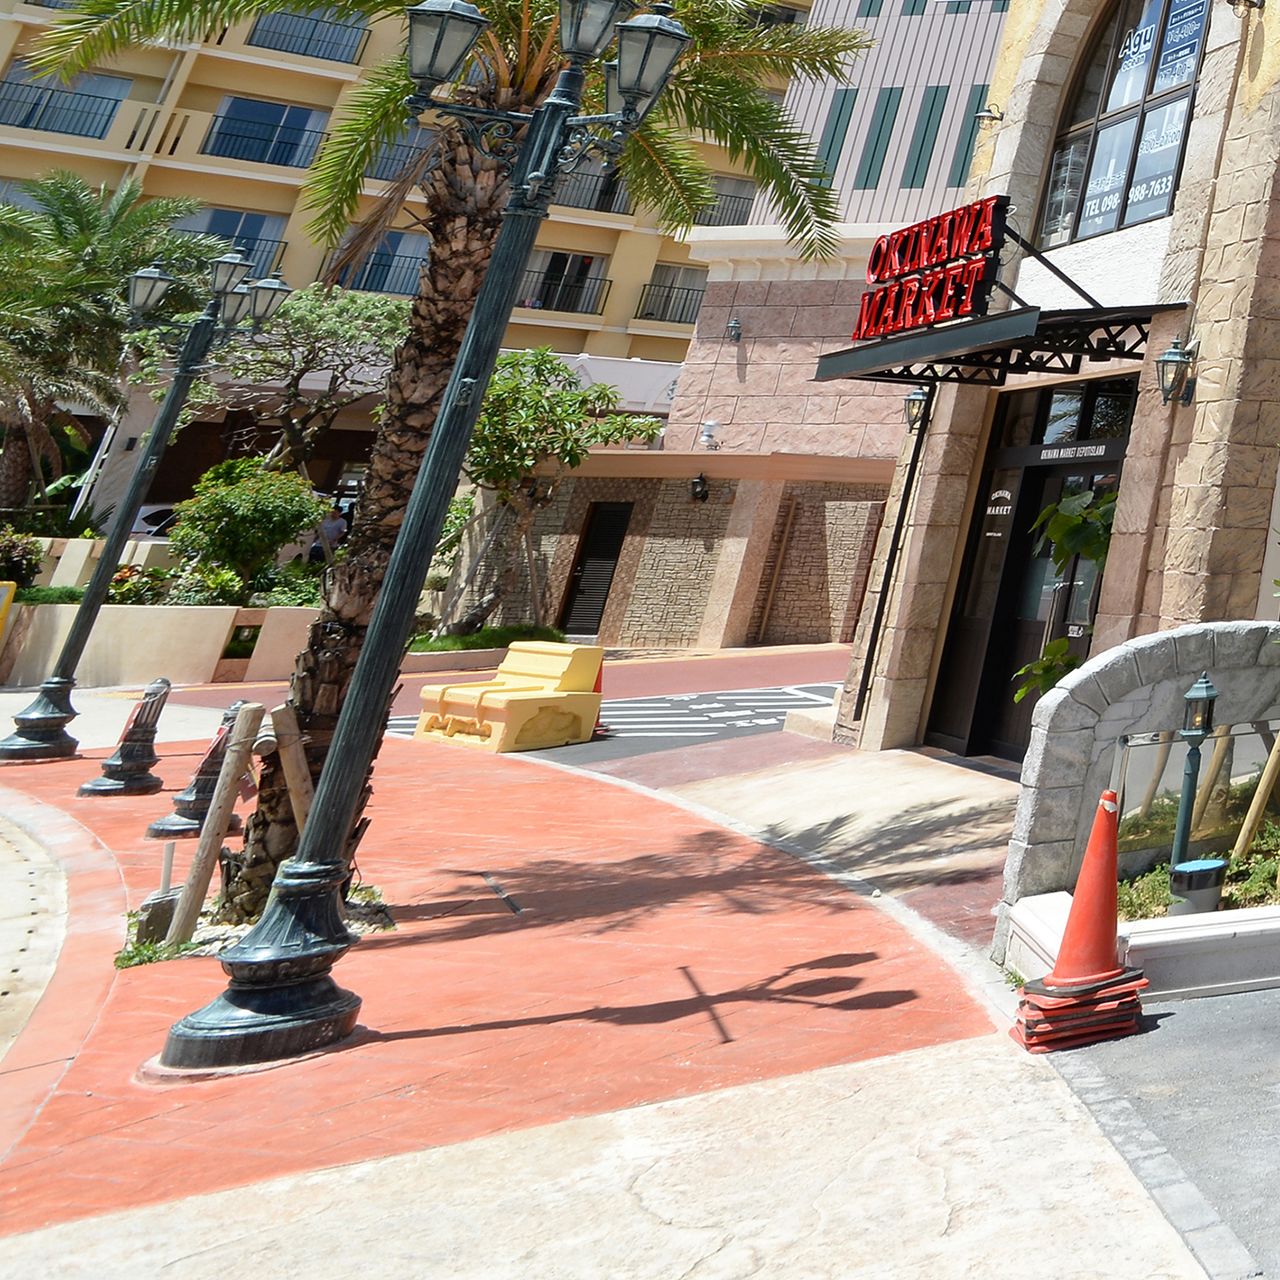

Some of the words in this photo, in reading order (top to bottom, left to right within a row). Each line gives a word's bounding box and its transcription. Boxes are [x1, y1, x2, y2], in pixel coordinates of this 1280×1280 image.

[1118, 24, 1155, 58] Agu
[1085, 198, 1100, 218] TEL
[1101, 192, 1120, 212] 098-
[866, 197, 997, 284] OKINAWA
[852, 258, 985, 340] MARKET
